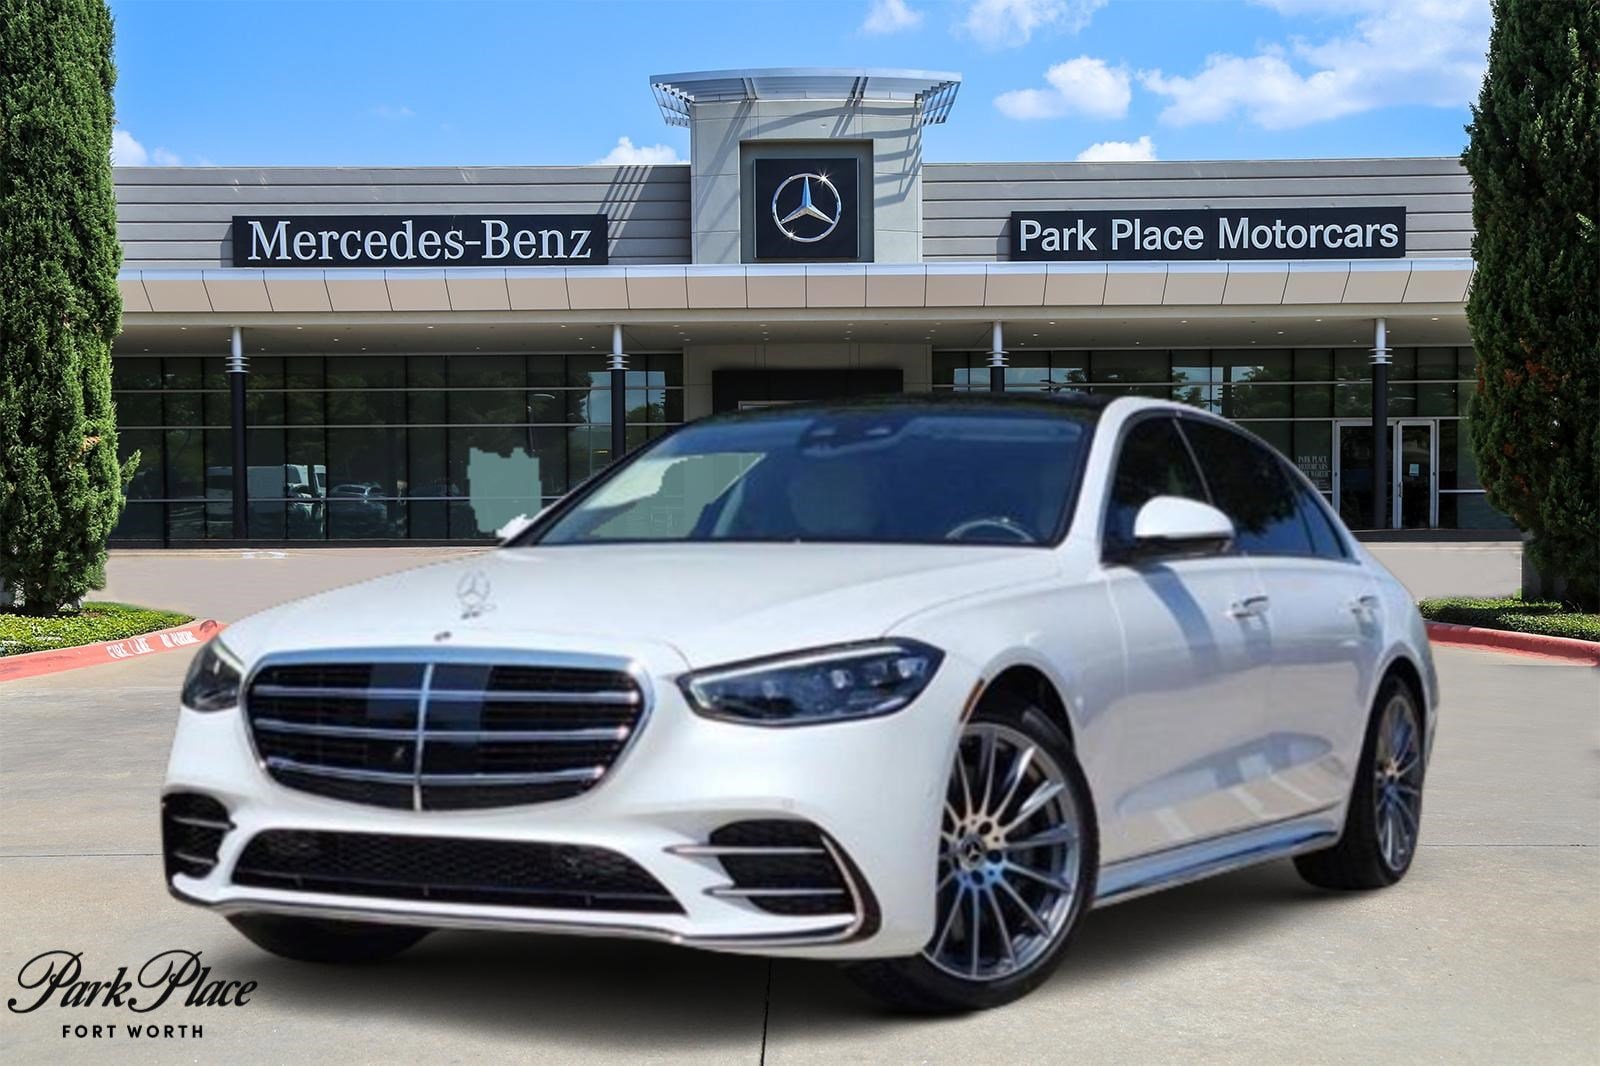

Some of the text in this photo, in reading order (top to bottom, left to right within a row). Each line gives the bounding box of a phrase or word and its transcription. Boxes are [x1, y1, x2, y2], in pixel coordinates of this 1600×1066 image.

[247, 219, 592, 261] Mercedes-Benz
[1019, 217, 1399, 252] Park Place Motorcars
